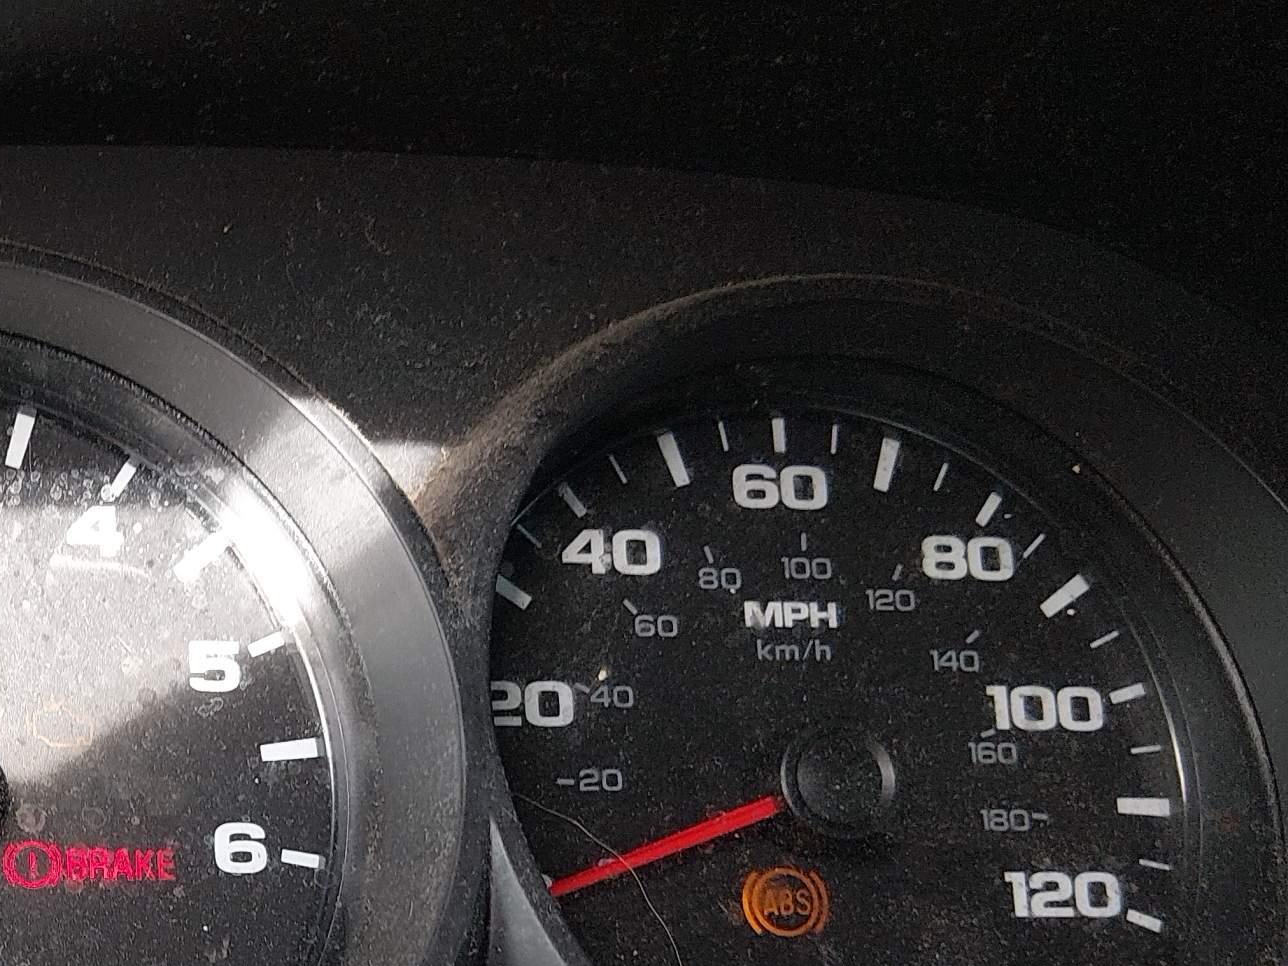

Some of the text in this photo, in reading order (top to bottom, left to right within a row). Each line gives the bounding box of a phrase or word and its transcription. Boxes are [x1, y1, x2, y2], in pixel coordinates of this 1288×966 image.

[732, 464, 828, 510] 60
[66, 505, 124, 556] 4
[562, 529, 661, 575] 40
[921, 535, 1014, 581] 80
[699, 567, 742, 591] 80
[781, 556, 832, 580] 100
[866, 589, 915, 612] 120
[634, 615, 678, 638] 60
[744, 601, 838, 628] MPH
[756, 639, 832, 662] km/h
[930, 649, 980, 673] 140
[188, 640, 241, 692] 5
[490, 680, 574, 727] 20
[590, 685, 635, 708] 40
[986, 685, 1104, 731] 100
[968, 742, 1017, 765] 160
[579, 769, 623, 792] 20
[980, 809, 1030, 832] 180
[214, 823, 267, 874] 6
[65, 847, 176, 881] BRAKE
[764, 889, 811, 916] ABS
[1004, 871, 1121, 918] 120
